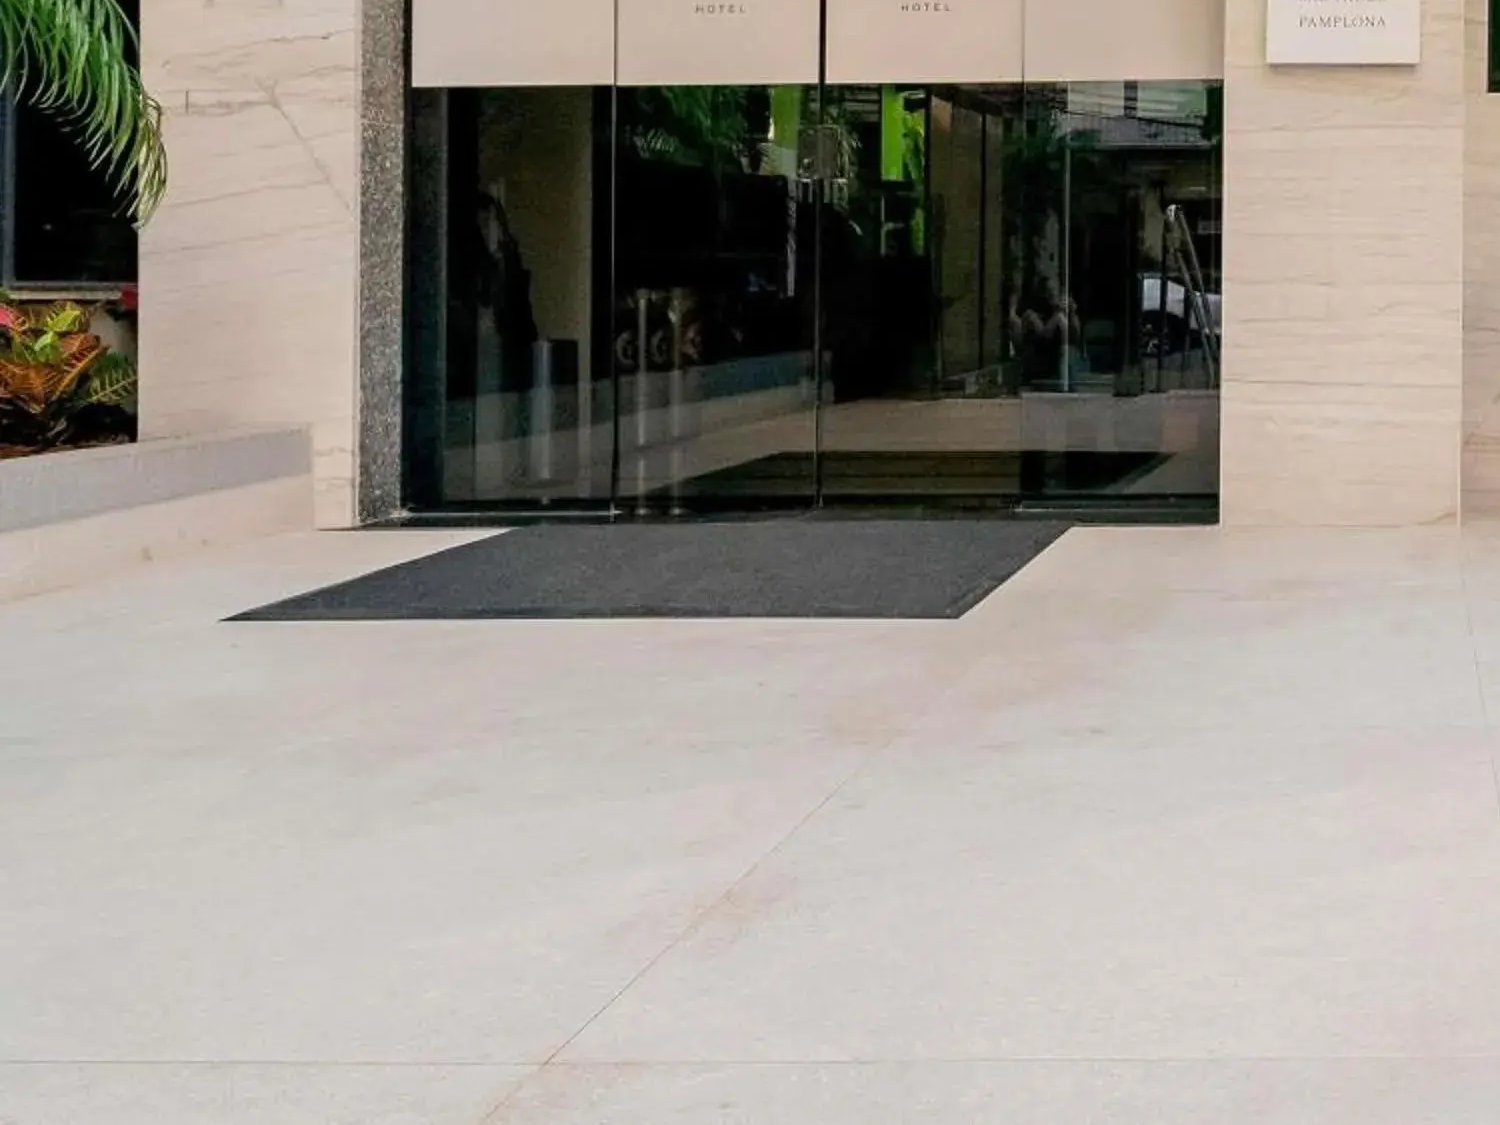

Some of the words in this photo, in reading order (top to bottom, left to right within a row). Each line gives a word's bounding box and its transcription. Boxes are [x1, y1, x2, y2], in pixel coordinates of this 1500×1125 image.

[694, 4, 746, 14] HOTEL
[900, 2, 951, 12] HOTEL
[1299, 15, 1386, 28] PAMPLONA
